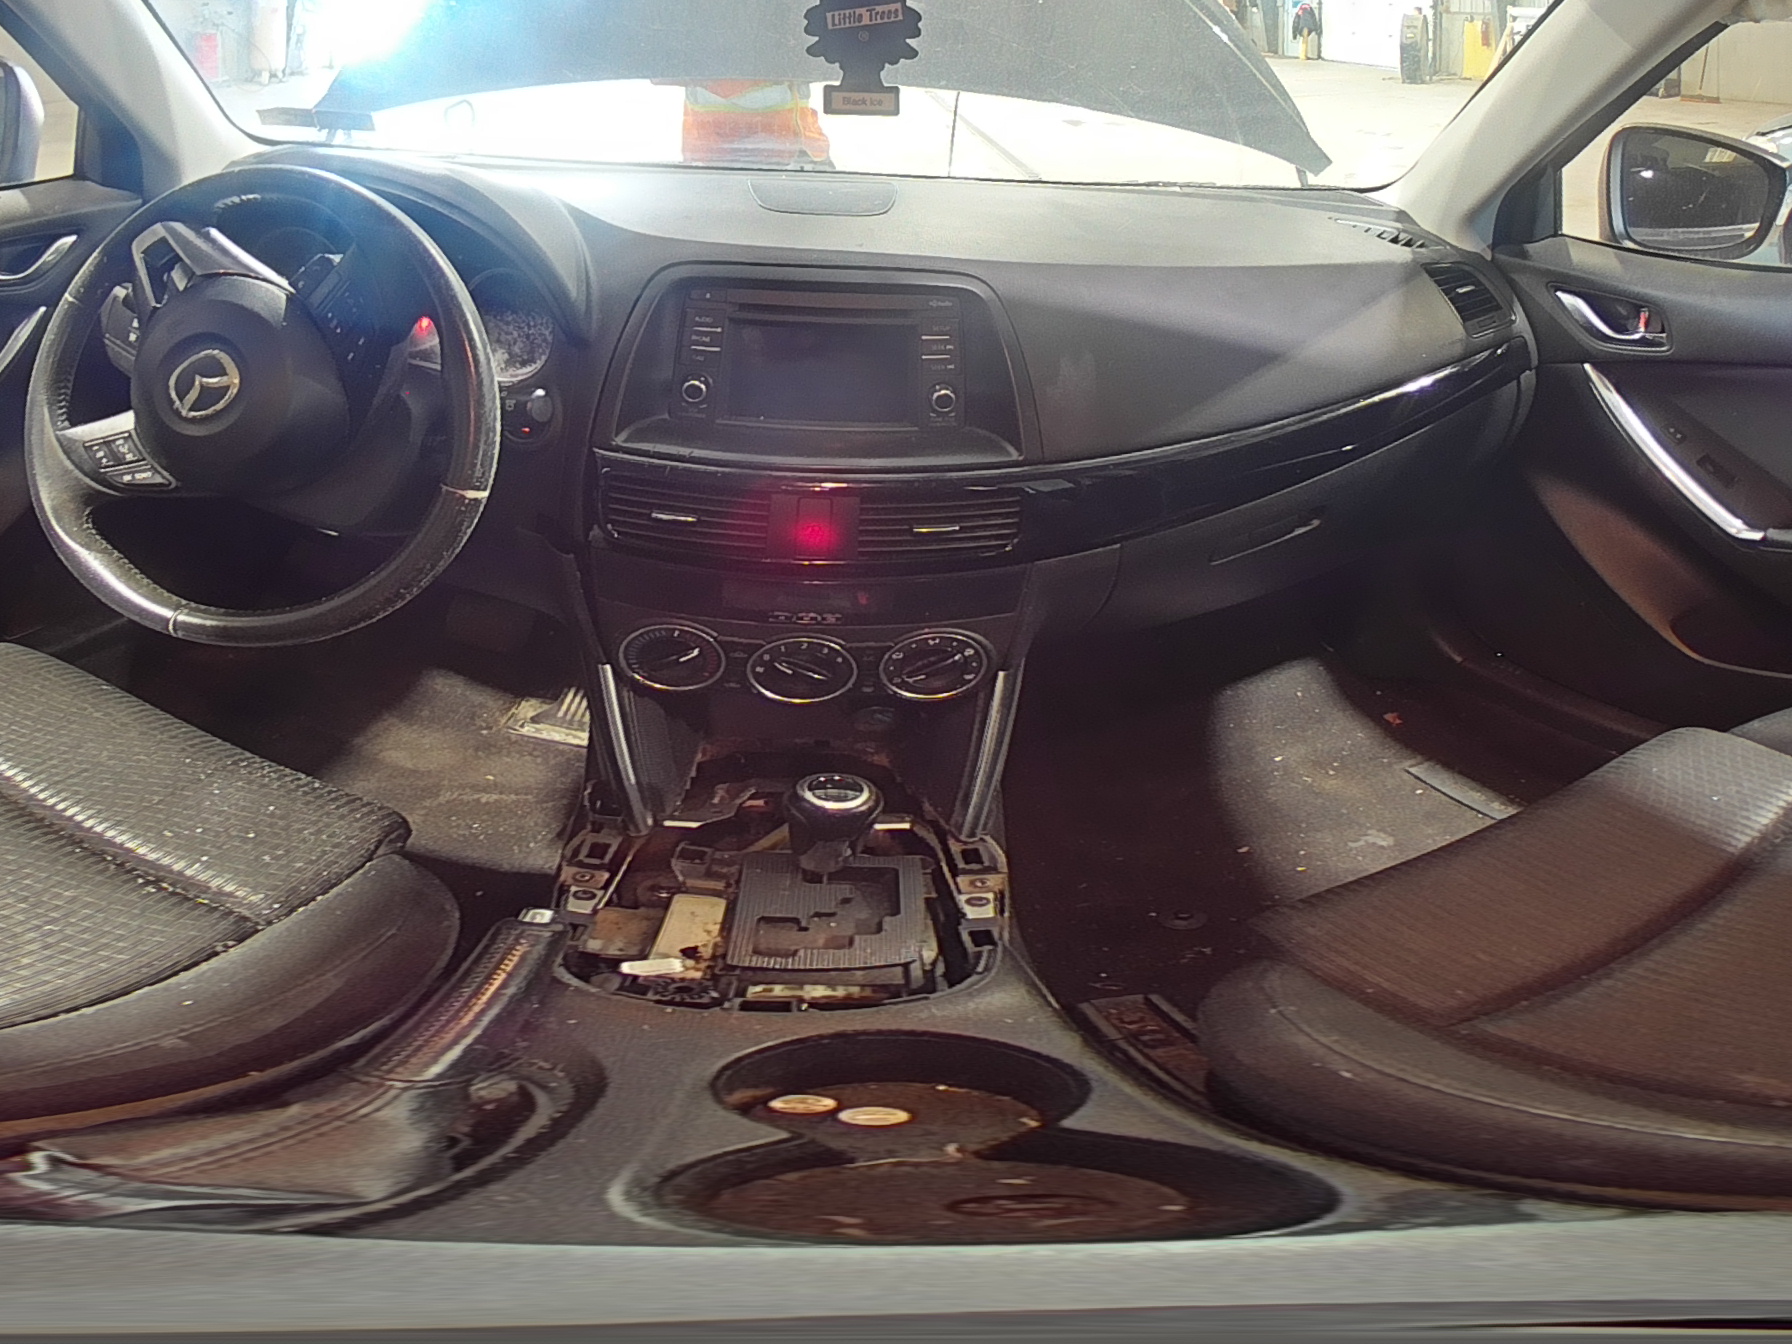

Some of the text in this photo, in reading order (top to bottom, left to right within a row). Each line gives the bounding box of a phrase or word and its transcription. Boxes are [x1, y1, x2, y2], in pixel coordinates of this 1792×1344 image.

[831, 7, 900, 28] Little Trees
[842, 96, 884, 107] Black Ice
